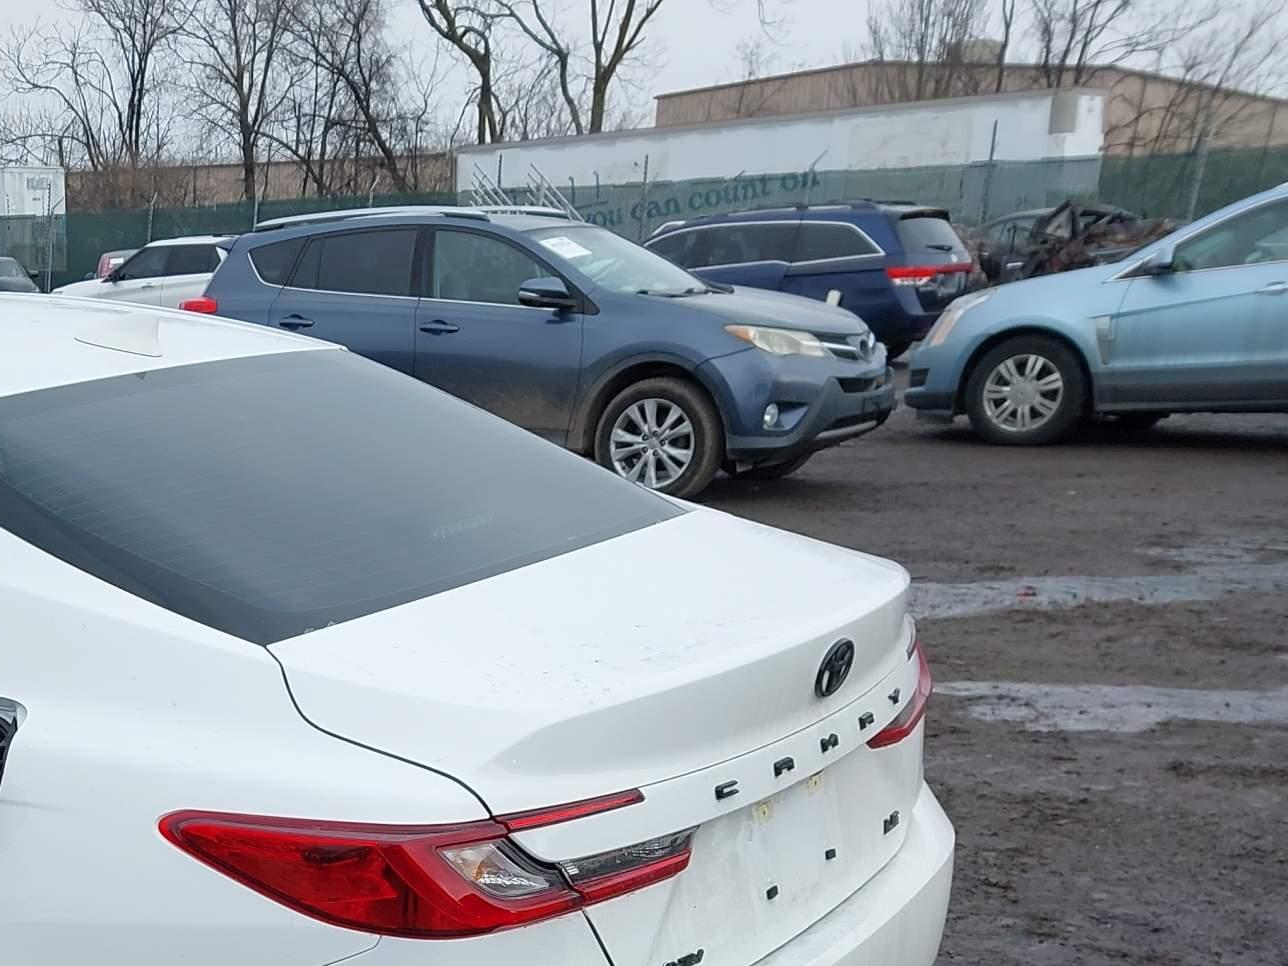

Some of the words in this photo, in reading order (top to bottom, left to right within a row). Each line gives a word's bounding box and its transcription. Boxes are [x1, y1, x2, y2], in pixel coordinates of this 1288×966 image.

[630, 197, 681, 220] can
[688, 172, 772, 211] count
[781, 171, 820, 192] on
[714, 687, 900, 801] CAMRY
